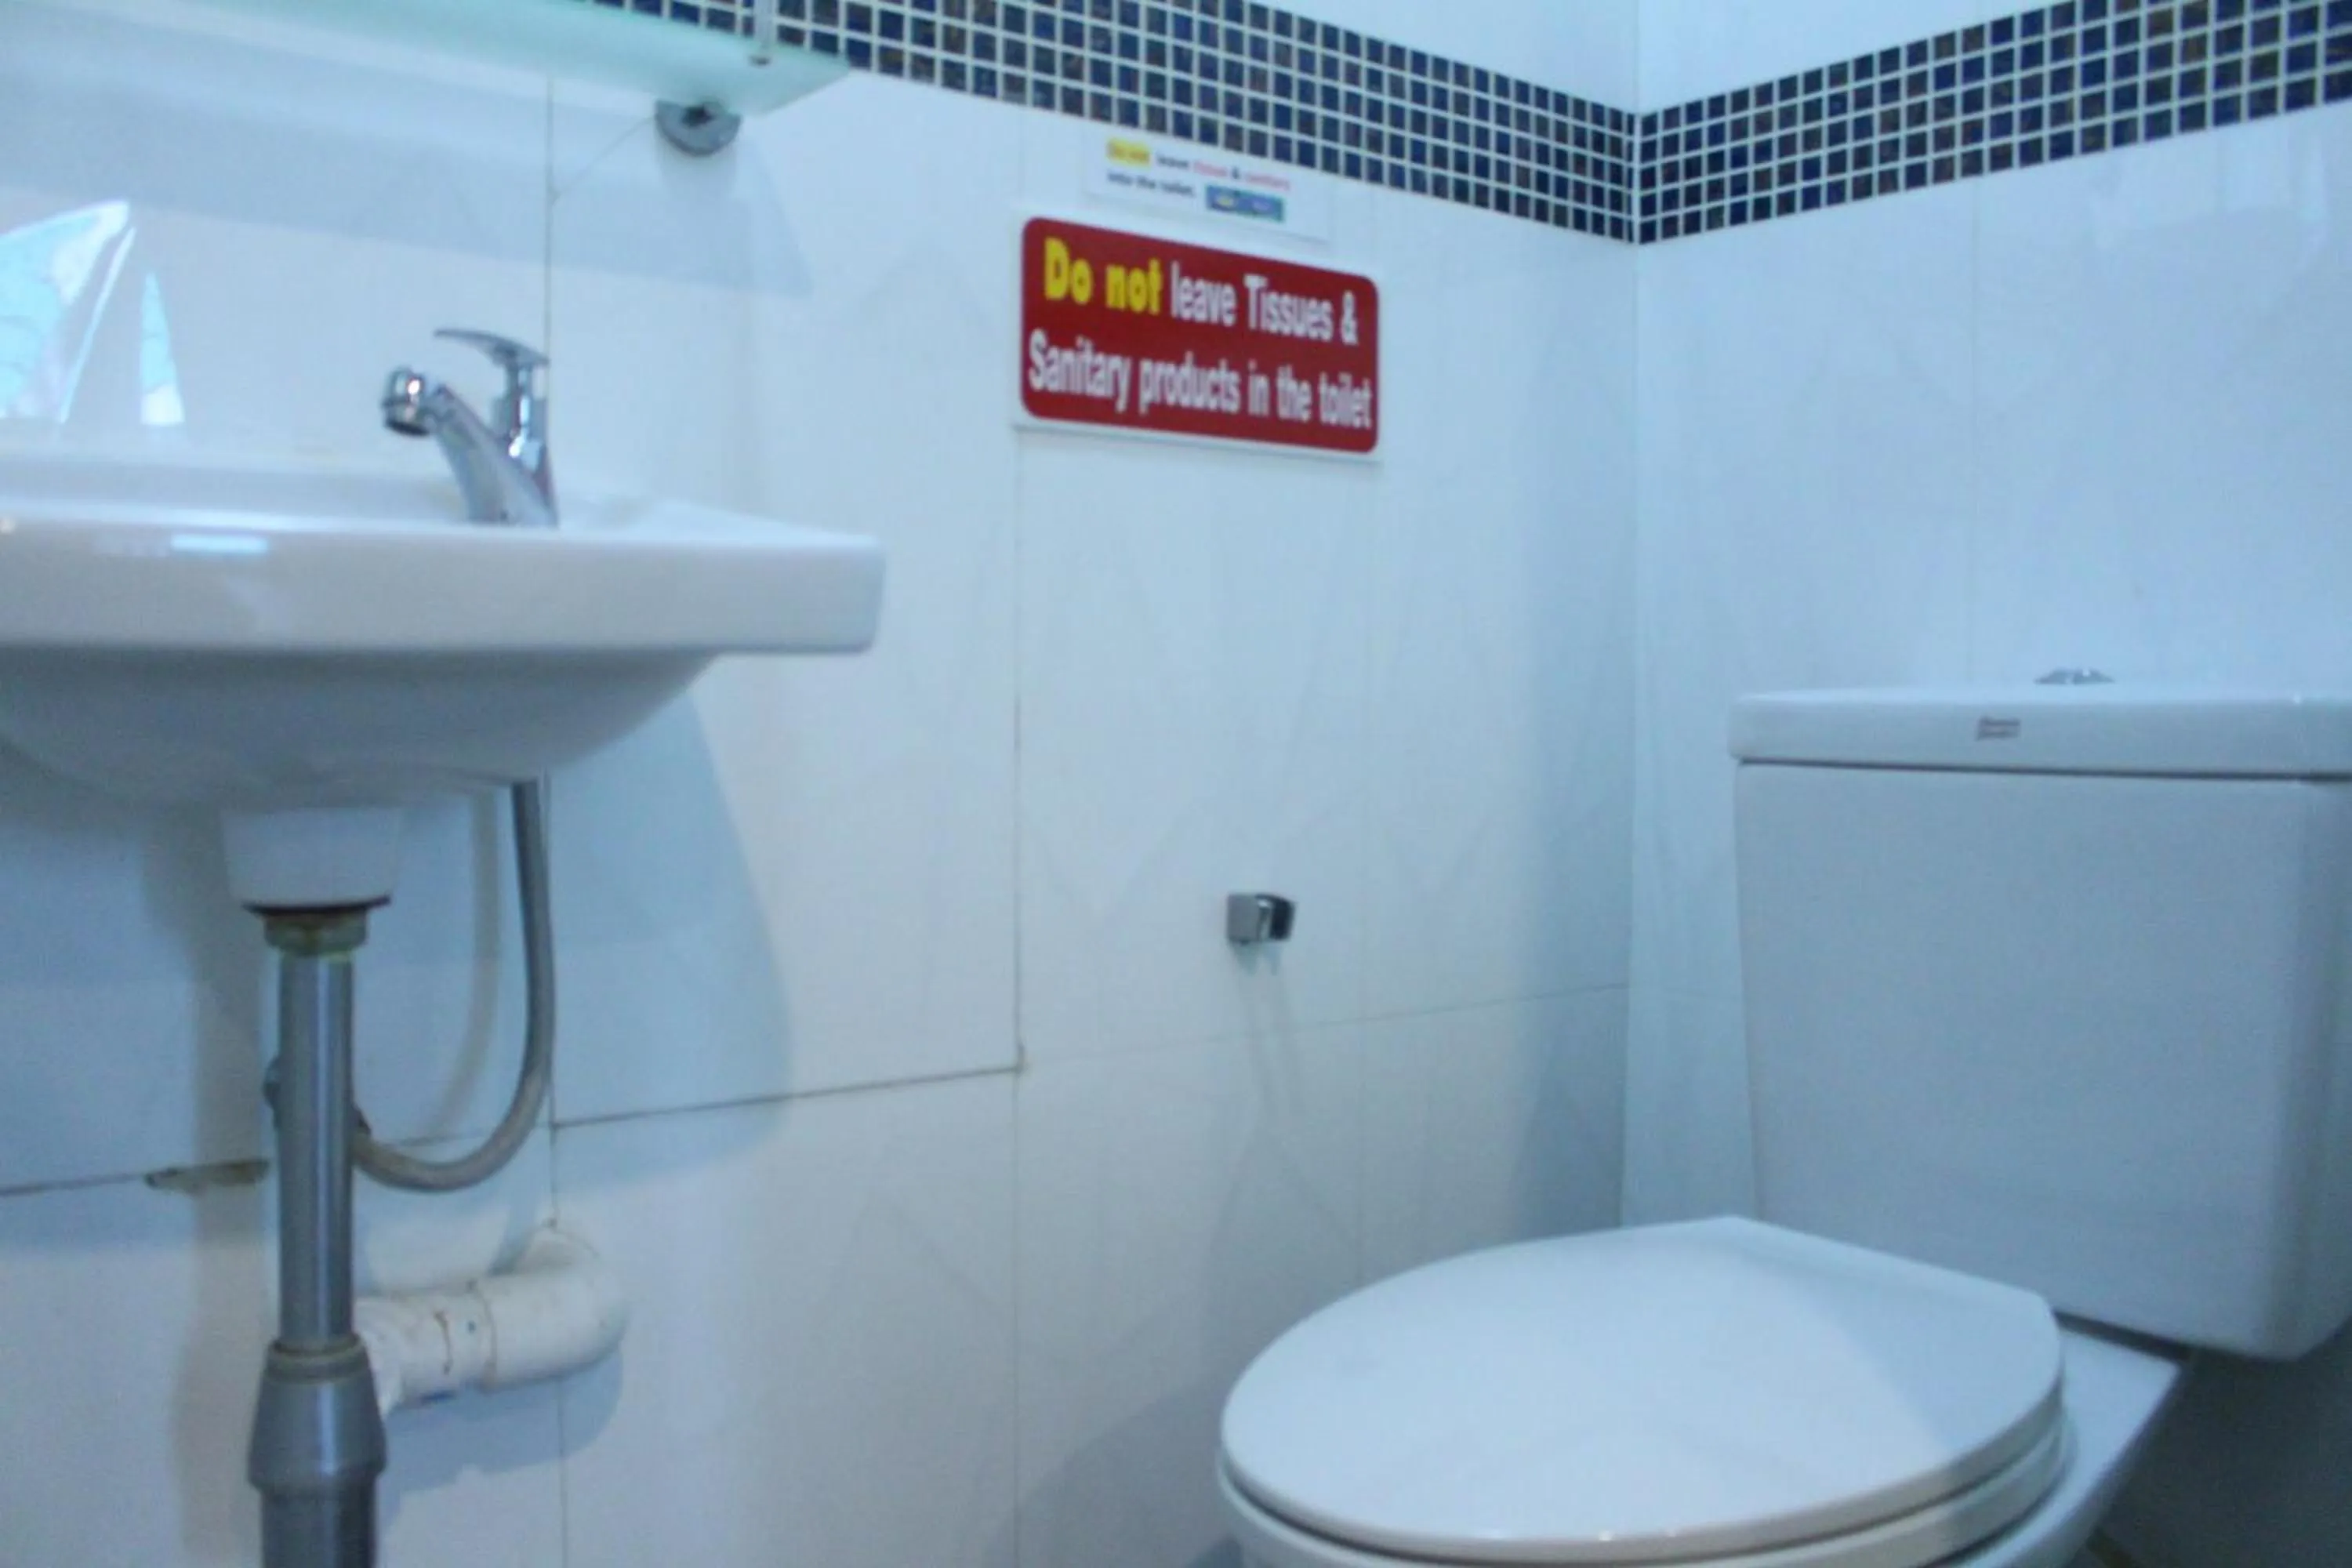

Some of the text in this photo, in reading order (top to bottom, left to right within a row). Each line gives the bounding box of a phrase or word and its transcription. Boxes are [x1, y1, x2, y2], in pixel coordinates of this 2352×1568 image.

[1044, 237, 1359, 345] Do not leave Tissues &
[1029, 328, 1372, 430] Sanitary products in the toilet
